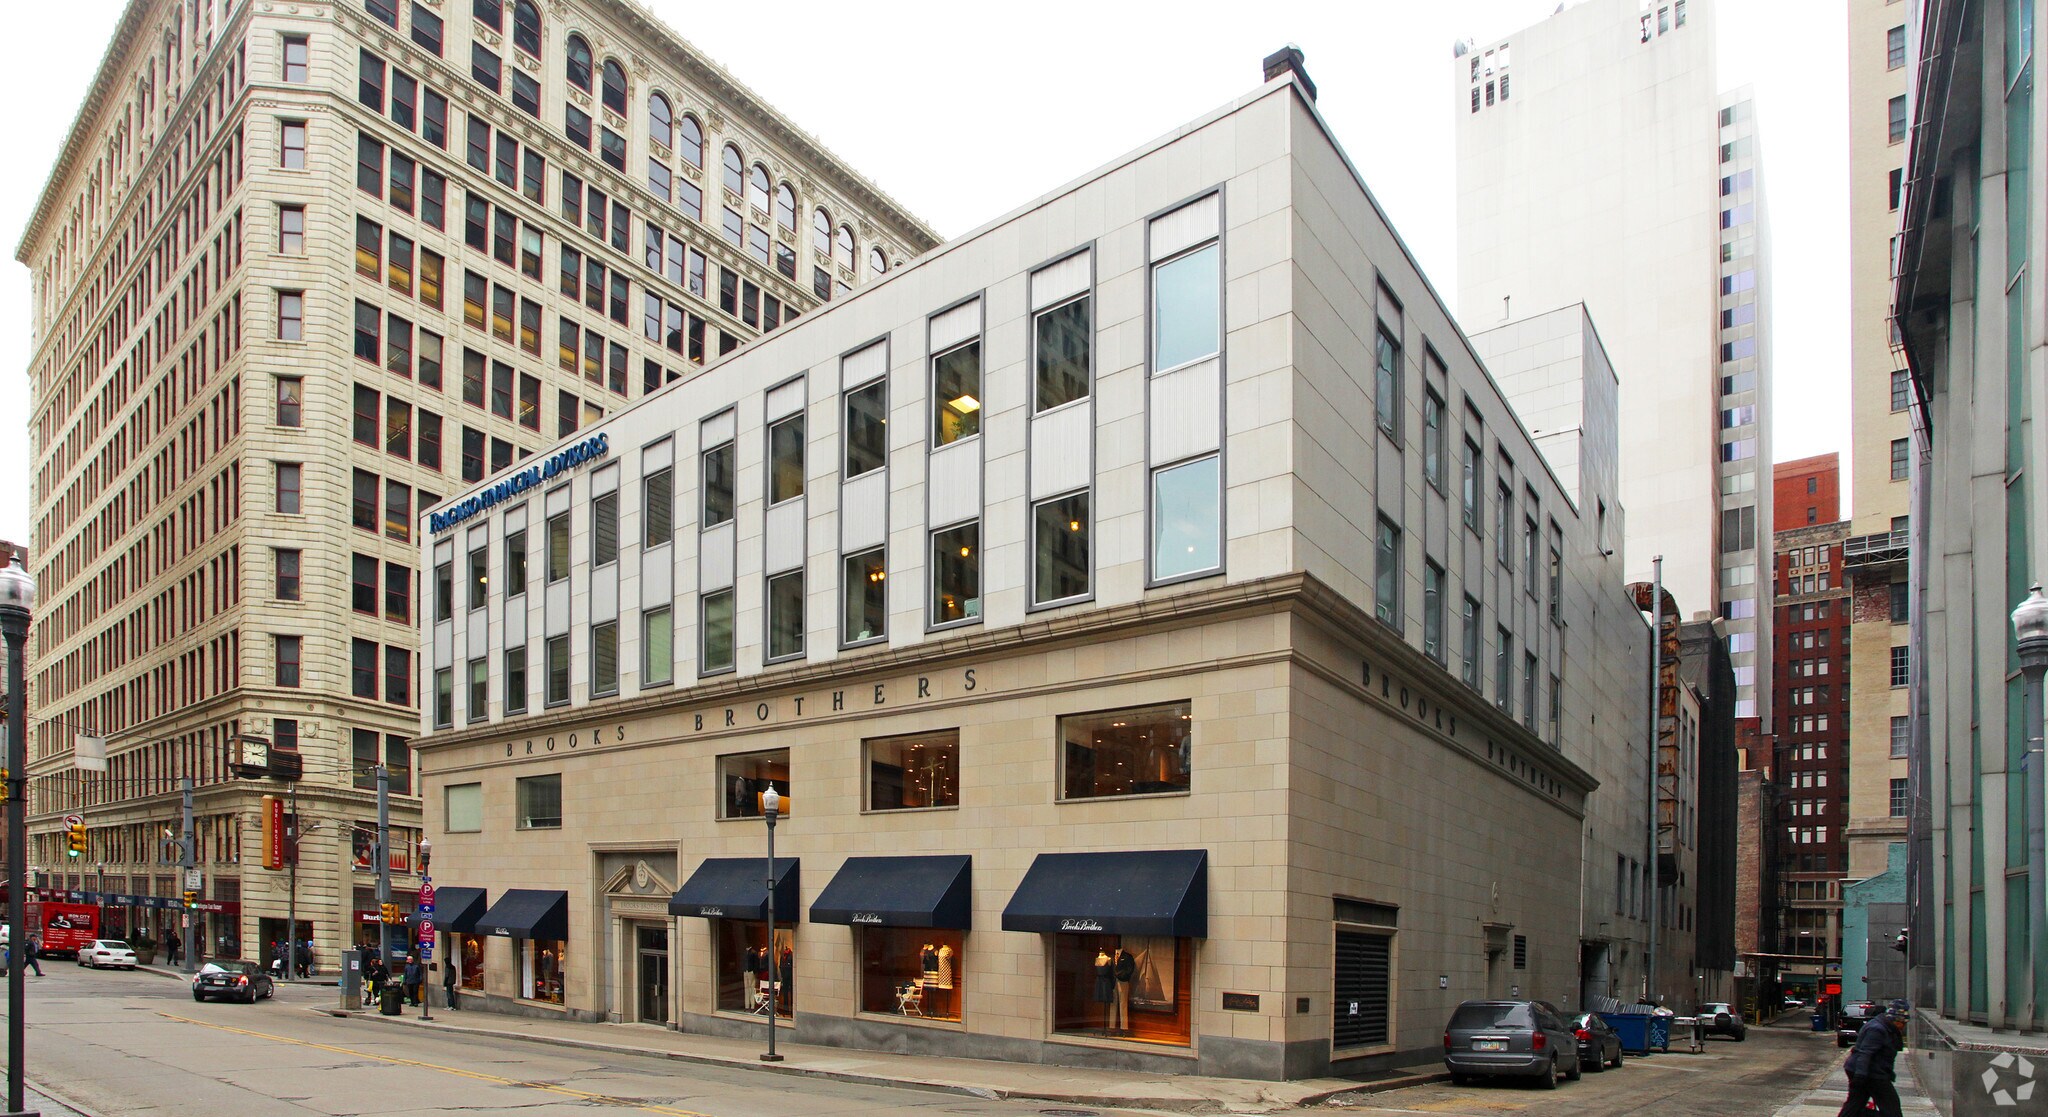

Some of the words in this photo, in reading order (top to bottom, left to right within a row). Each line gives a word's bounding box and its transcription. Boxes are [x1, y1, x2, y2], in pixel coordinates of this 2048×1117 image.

[429, 496, 481, 535] FRAGASSO
[480, 465, 543, 510] FINANCIAL
[541, 432, 609, 481] ADVISORS
[506, 725, 625, 757] BROOKS
[694, 669, 977, 732] BROTHERS
[1362, 661, 1456, 737] BROOKS
[1487, 739, 1562, 799] BROTHERS
[424, 885, 431, 894] P
[424, 922, 431, 931] P
[1061, 919, 1080, 930] Brooks
[1080, 918, 1103, 931] Brothers
